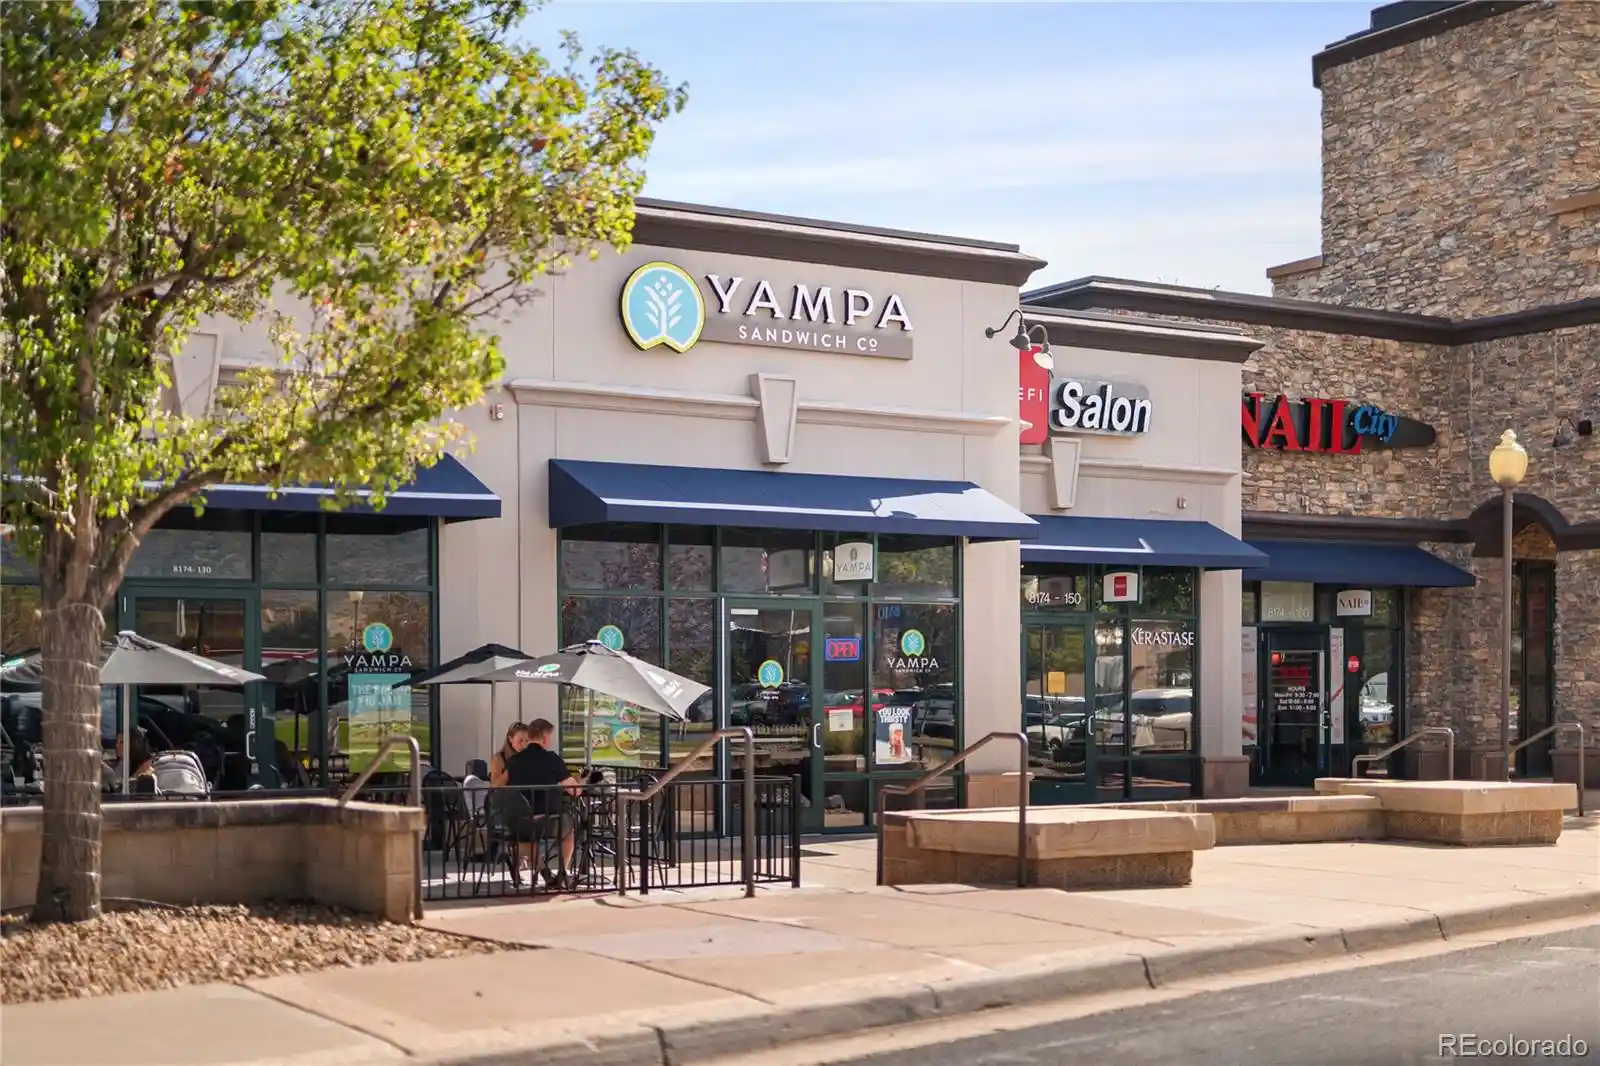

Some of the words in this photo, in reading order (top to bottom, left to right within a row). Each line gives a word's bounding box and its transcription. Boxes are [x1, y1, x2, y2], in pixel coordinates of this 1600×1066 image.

[705, 274, 914, 331] YAMPA
[738, 325, 847, 349] SANDWICH
[1056, 381, 1152, 433] Salon
[1241, 391, 1362, 455] NAIL
[1353, 404, 1399, 443] City
[836, 562, 871, 573] YAMPA
[1028, 592, 1050, 604] 8174
[1064, 592, 1081, 605] 150
[827, 641, 858, 658] OPEN
[344, 655, 412, 667] YAMPA
[887, 657, 939, 668] YAMPA
